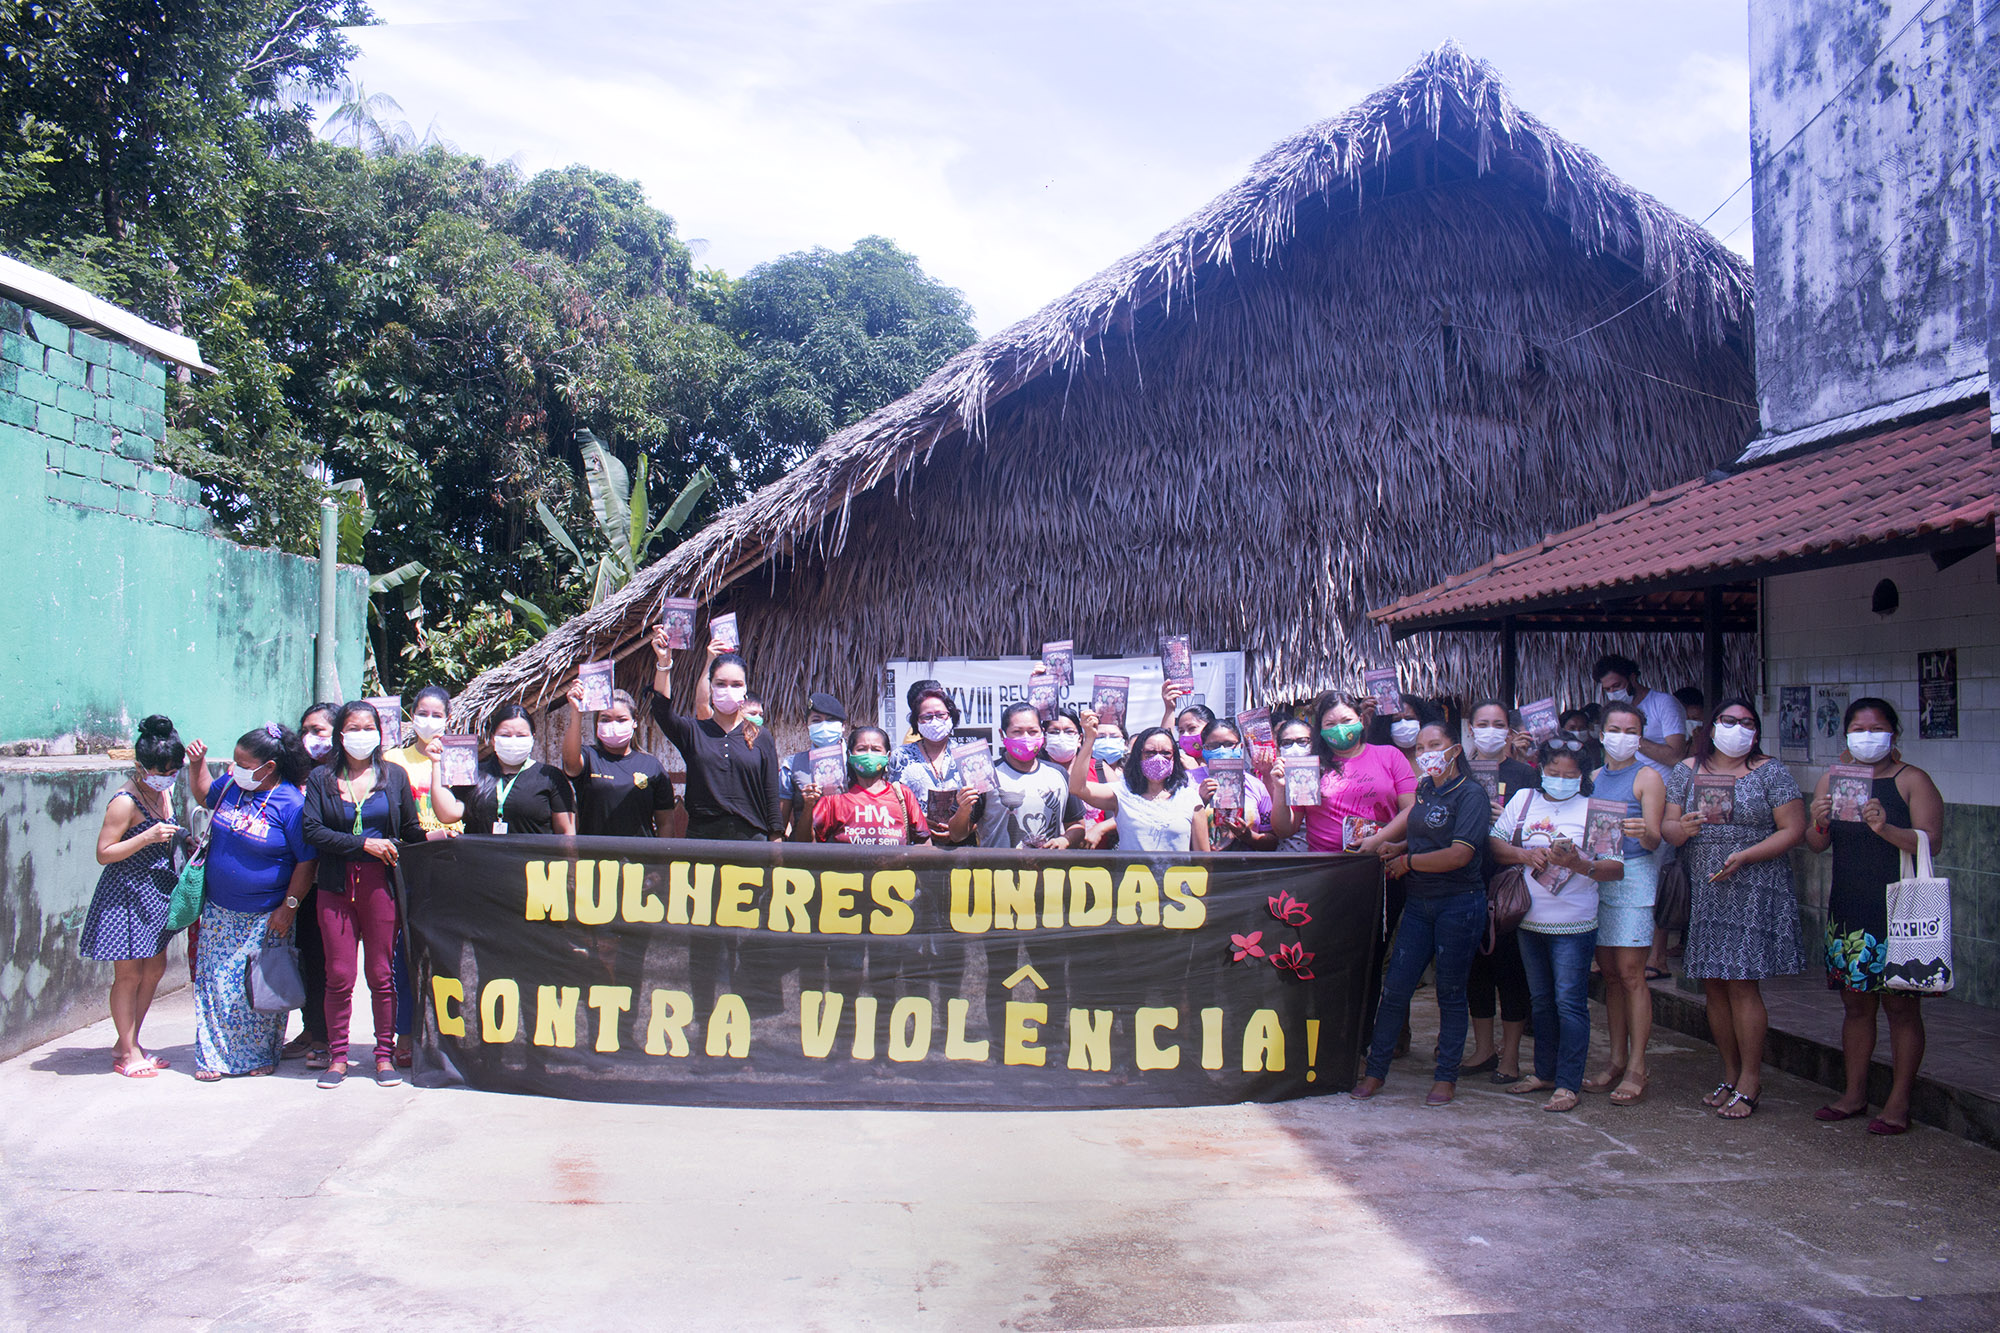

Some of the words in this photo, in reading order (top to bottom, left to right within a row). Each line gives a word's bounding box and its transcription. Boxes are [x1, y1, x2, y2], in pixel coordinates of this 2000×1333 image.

[1922, 655, 1949, 679] HIV
[999, 685, 1070, 702] REUO
[868, 827, 876, 835] o
[878, 837, 900, 846] sem
[525, 859, 917, 935] MULHERES
[949, 864, 1209, 934] UNIDAS
[432, 975, 752, 1058] CONTRA
[800, 964, 1321, 1083] VIOLÊNCIA!
